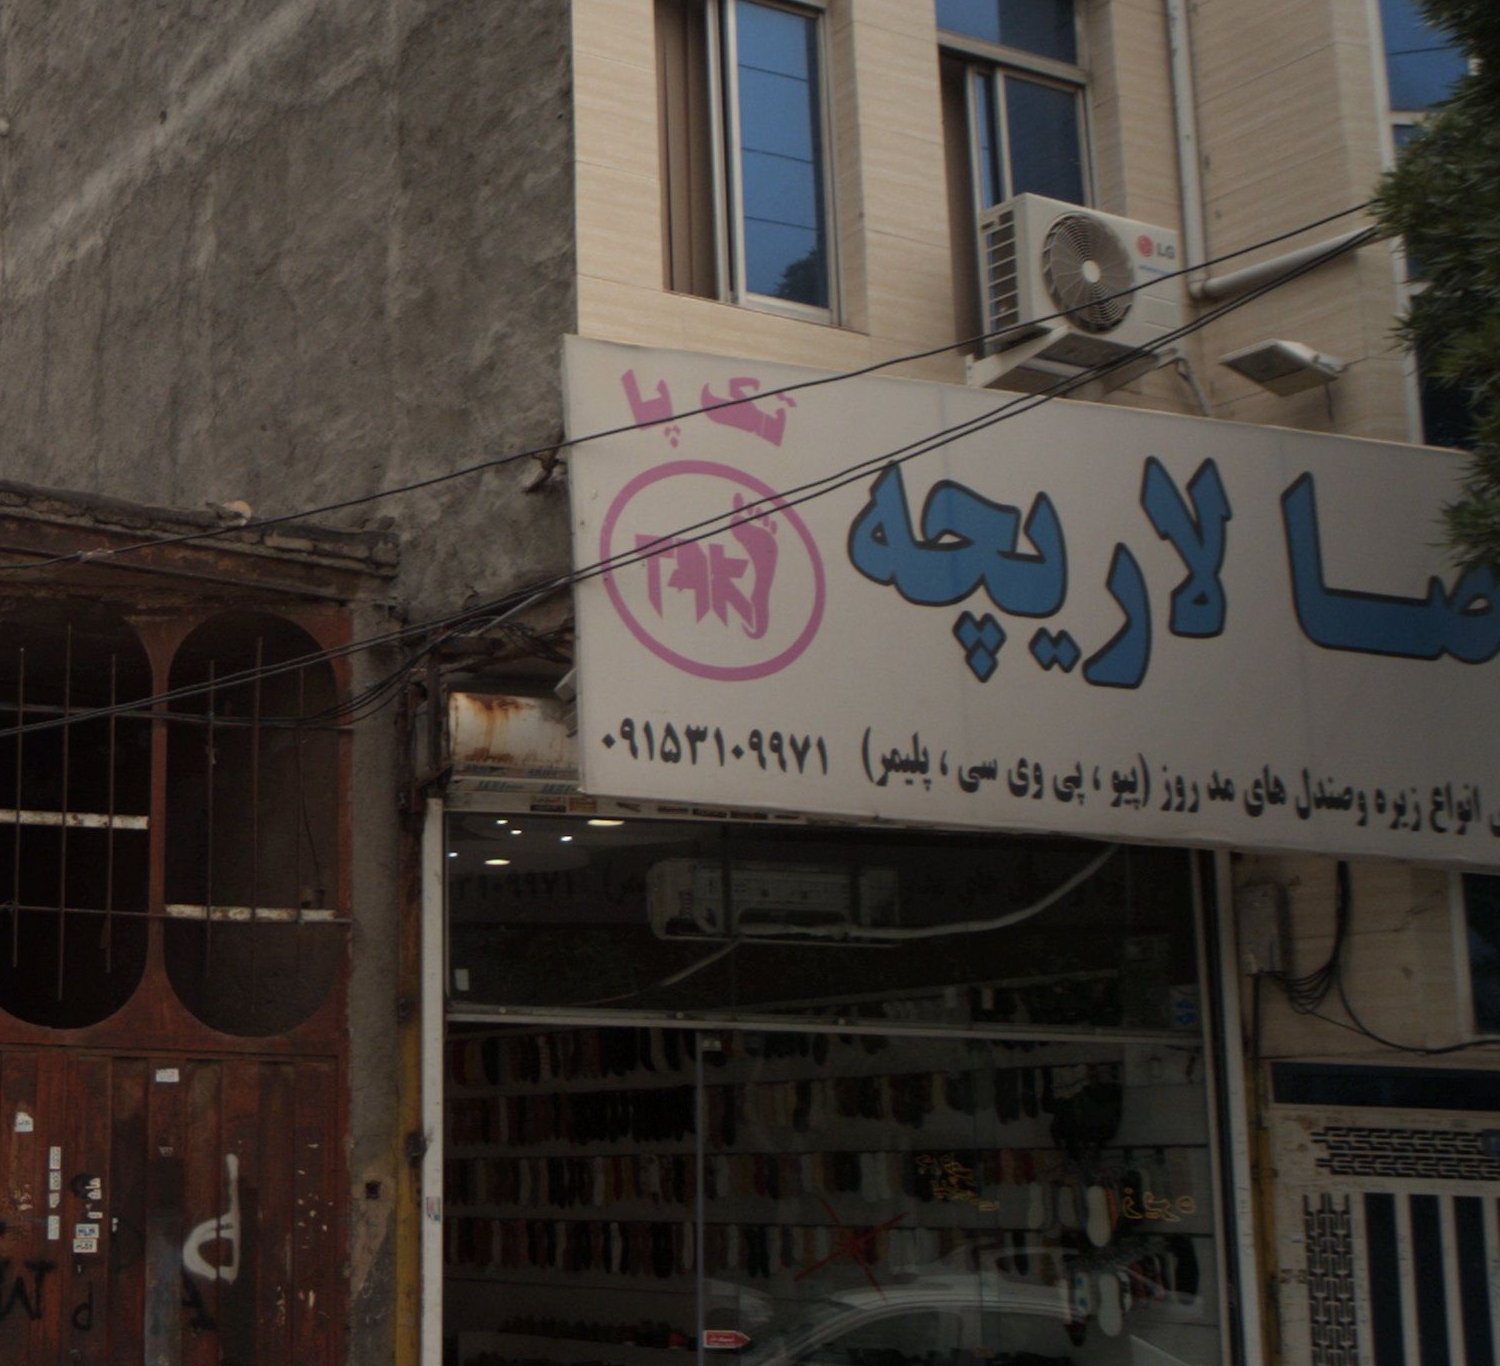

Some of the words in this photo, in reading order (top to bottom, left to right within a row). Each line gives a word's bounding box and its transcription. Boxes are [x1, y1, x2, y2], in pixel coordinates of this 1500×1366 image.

[1156, 242, 1175, 259] LG
[601, 716, 829, 775] ۰۹۱۵۳۱۰۹۹۷۱
[1161, 764, 1200, 813] روز
[1207, 769, 1234, 803] مد
[1244, 763, 1287, 817] های
[1429, 781, 1481, 835] انواع
